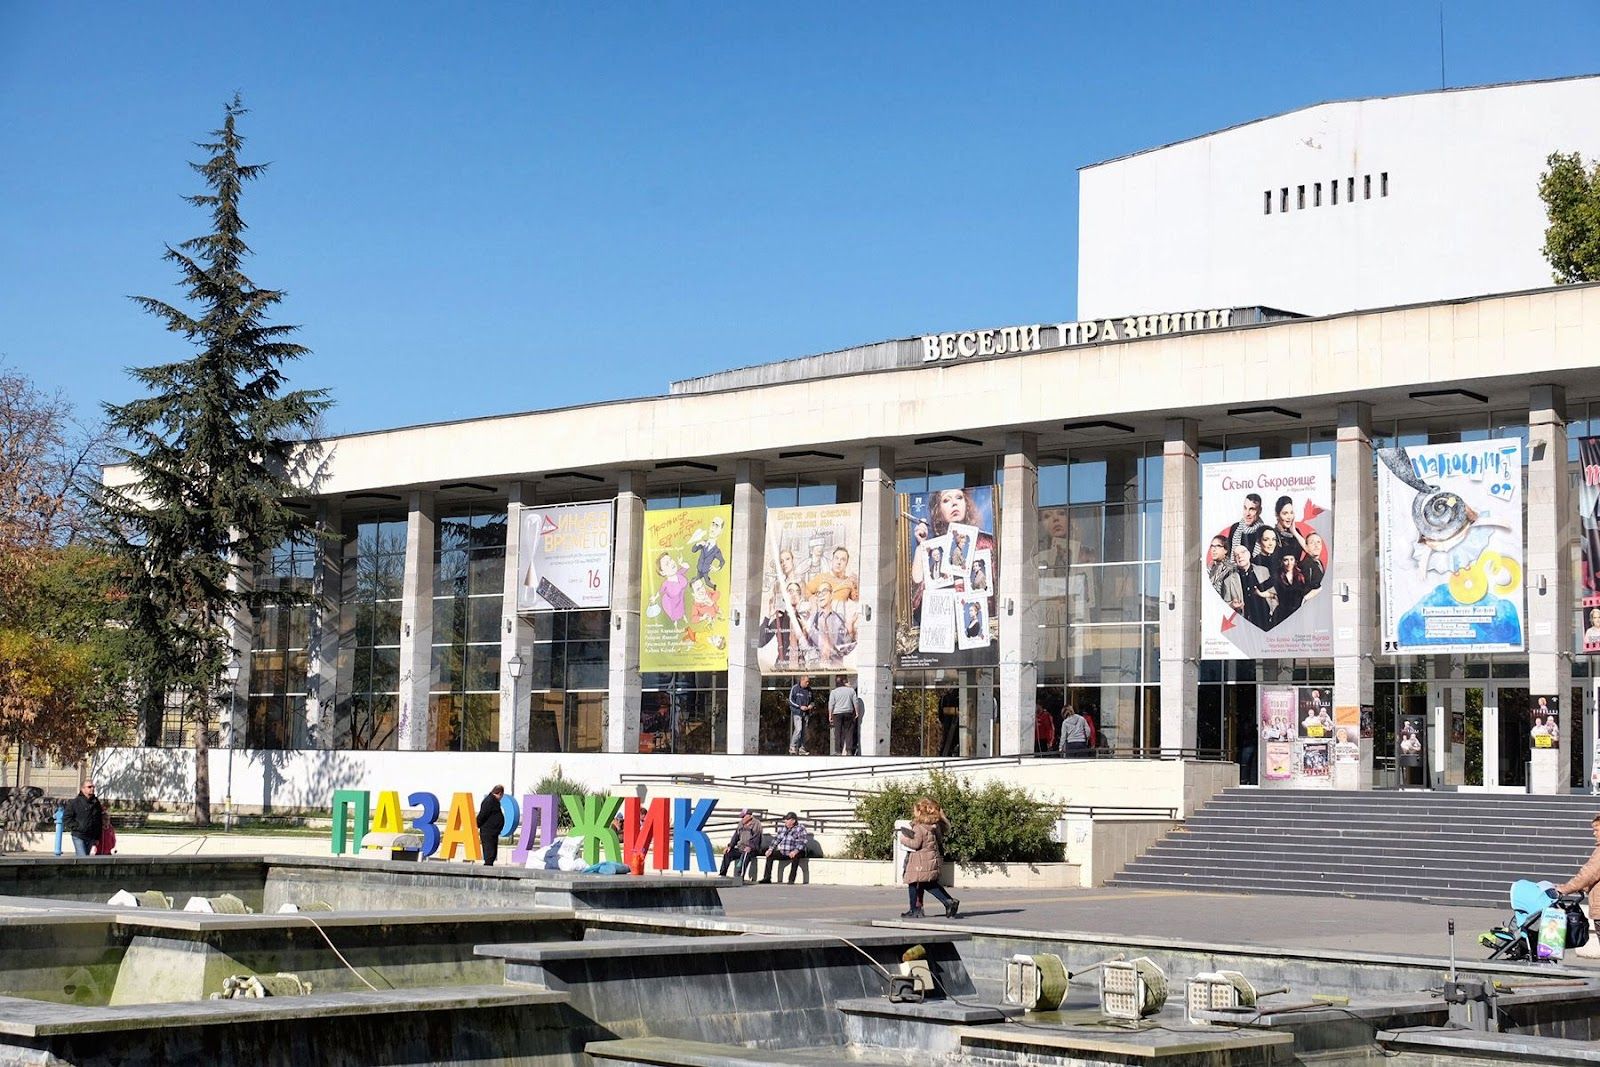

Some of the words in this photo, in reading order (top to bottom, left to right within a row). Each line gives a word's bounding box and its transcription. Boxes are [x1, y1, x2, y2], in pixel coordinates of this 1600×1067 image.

[921, 324, 1042, 362] ВЕСЕЛИ
[1057, 308, 1233, 347] ПРАЗНИЦИ
[1222, 476, 1254, 491] Скъпо
[1257, 473, 1316, 491] Съкровище
[587, 569, 601, 589] 16
